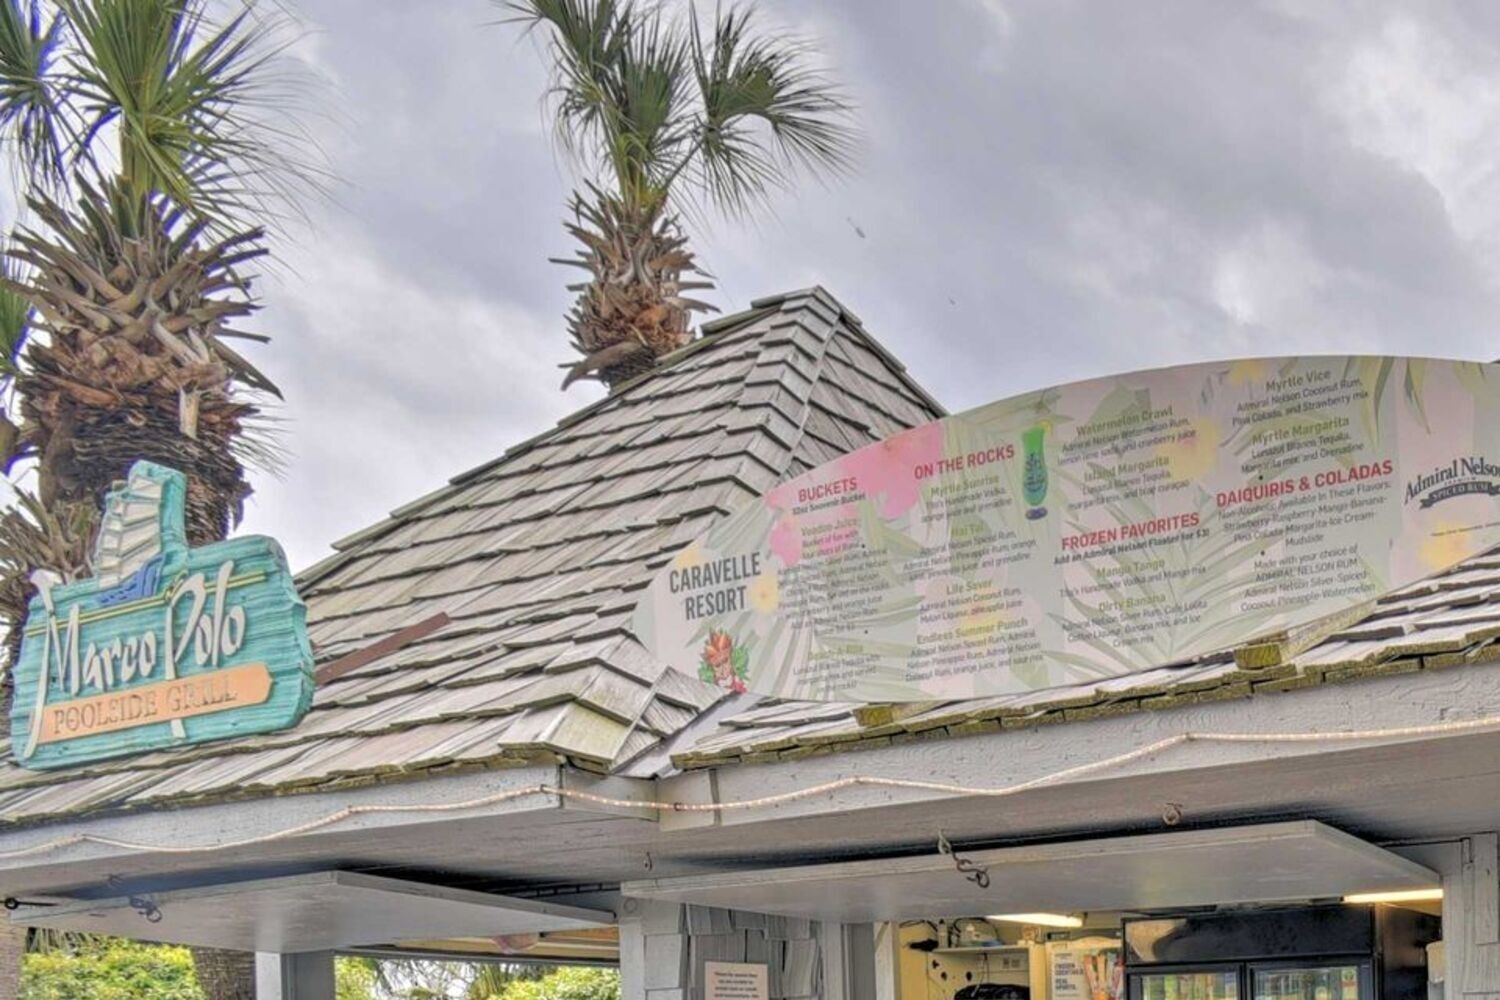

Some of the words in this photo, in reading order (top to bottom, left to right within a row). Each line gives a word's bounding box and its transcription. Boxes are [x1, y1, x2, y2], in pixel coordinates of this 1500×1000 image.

[1266, 377, 1303, 392] Myrtle
[1306, 369, 1331, 383] Vice
[1237, 401, 1269, 412] Admiral
[1271, 392, 1300, 405] Nelson
[1303, 384, 1338, 398] Coconut
[1286, 404, 1301, 414] and
[1303, 396, 1350, 412] Strawberry
[1076, 413, 1140, 437] Watermelon
[1141, 405, 1173, 420] Crawl
[1251, 428, 1289, 444] Myrtle
[1292, 417, 1349, 435] Margarita
[914, 464, 934, 480] ON
[937, 456, 964, 474] THE
[967, 444, 1015, 468] ROCKS
[1118, 456, 1170, 474] Margarita
[1303, 450, 1318, 461] and
[798, 476, 858, 502] BUCKETS
[1216, 479, 1295, 508] DAIQUIRIS
[1299, 475, 1311, 491] &
[1314, 459, 1393, 488] COLADAS
[1329, 486, 1354, 499] These
[1404, 459, 1458, 505] Admiral
[1431, 484, 1466, 501] SPICED
[840, 493, 866, 504] Bucket
[1061, 528, 1118, 551] FROZEN
[1120, 512, 1200, 540] FAVORITES
[1284, 533, 1325, 547] Mudslide
[1053, 555, 1070, 565] Add
[1083, 545, 1117, 560] Admiral
[1117, 541, 1148, 553] Nelson
[1254, 558, 1278, 570] Made
[1279, 554, 1298, 565] with
[1319, 547, 1348, 560] choice
[669, 552, 762, 593] CARAVELLE
[1256, 569, 1295, 582] ADMIRAL
[1297, 562, 1335, 576] NELSON
[1336, 558, 1359, 570] RUM
[966, 579, 992, 592] Saver
[1244, 585, 1278, 598] Admiral
[1279, 580, 1309, 592] Nelson
[685, 585, 748, 621] RESORT
[1099, 600, 1125, 613] Dirty
[1126, 594, 1166, 608] Banana
[916, 630, 953, 645] Endless
[955, 623, 995, 639] Summer
[997, 616, 1029, 630] Punch
[25, 570, 157, 757] Marco
[165, 560, 246, 738] Polo
[54, 690, 158, 734] POOLSIDE
[165, 674, 238, 718] GRILL
